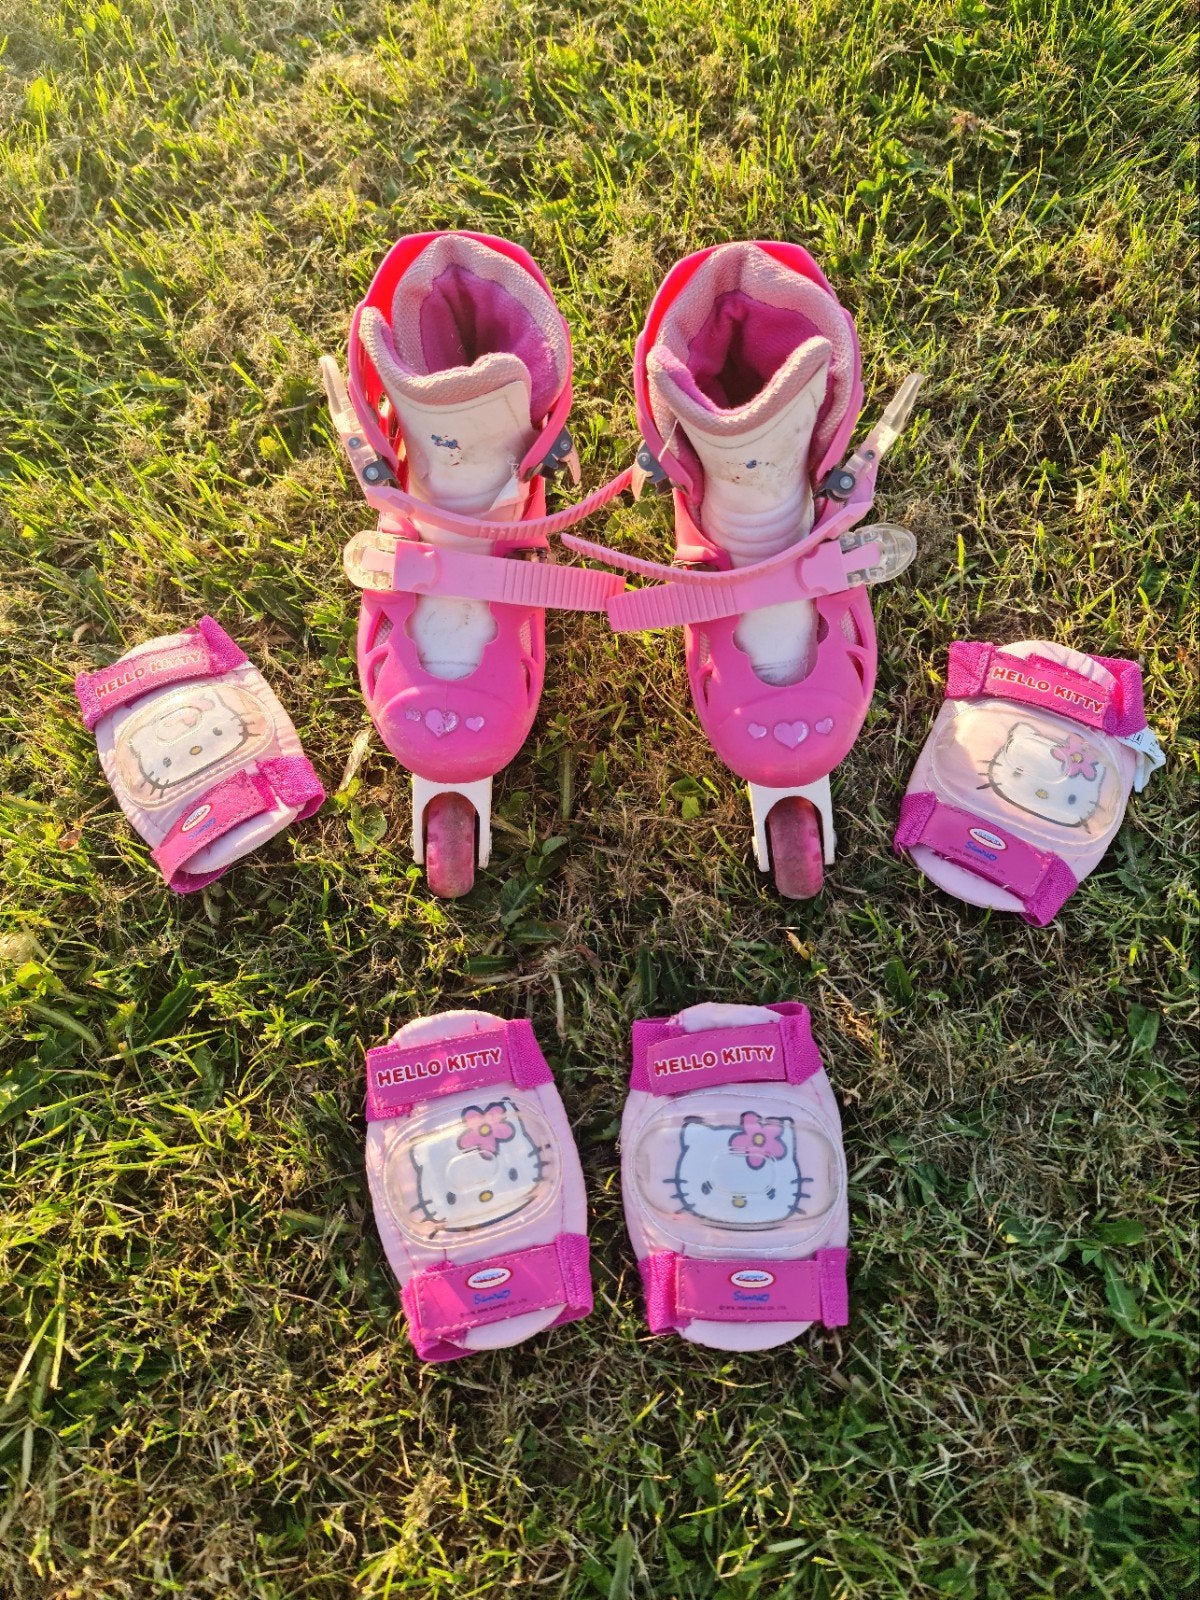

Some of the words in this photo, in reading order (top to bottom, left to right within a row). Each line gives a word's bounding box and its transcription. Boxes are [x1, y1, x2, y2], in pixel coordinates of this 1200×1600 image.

[95, 668, 146, 698] HELLO
[992, 666, 1050, 691] HELLO
[1053, 684, 1104, 714] KITTY
[376, 1059, 442, 1088] HELLO
[446, 1047, 502, 1072] KITTY
[653, 1050, 718, 1077] HELLO
[720, 1045, 775, 1066] KITTY
